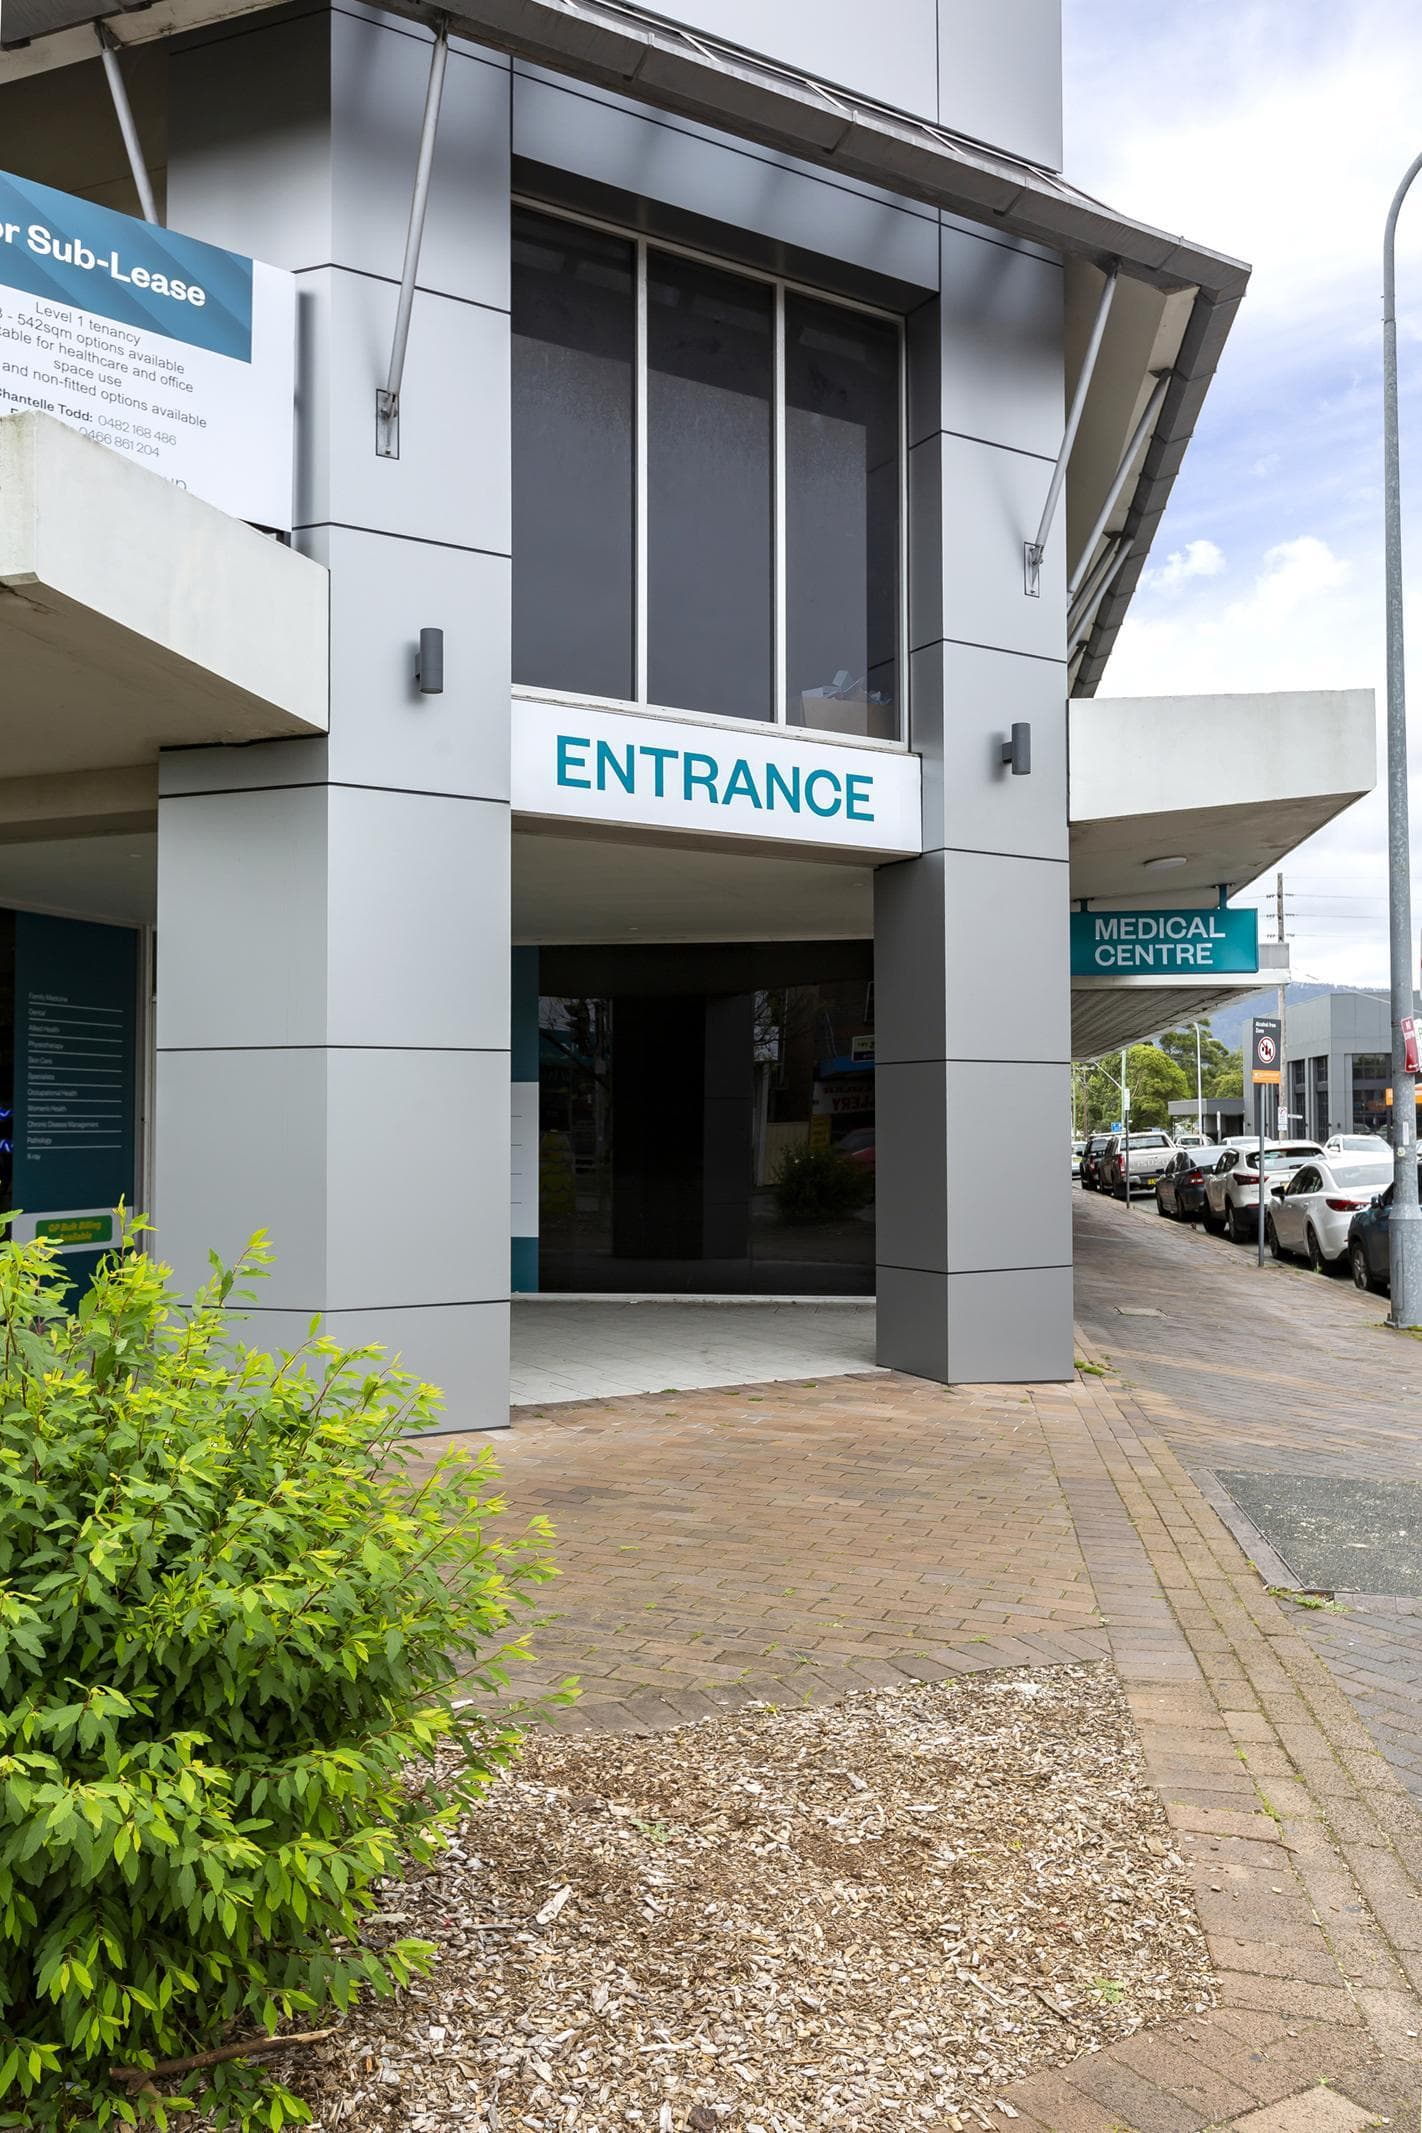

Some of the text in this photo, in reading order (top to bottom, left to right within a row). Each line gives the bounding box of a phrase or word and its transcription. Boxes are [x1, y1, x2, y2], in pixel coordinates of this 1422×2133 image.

[27, 224, 206, 307] Sub-Lease
[17, 313, 72, 340] 542sqm
[76, 334, 125, 356] options
[128, 349, 185, 374] available
[36, 301, 141, 347] Level 1 tenancy
[37, 335, 55, 351] for
[59, 342, 129, 373] healthcare
[132, 367, 156, 381] and
[160, 375, 194, 393] office
[53, 360, 122, 388] space use
[2, 362, 207, 428] and non-fitted options available
[57, 403, 93, 423] Todd:
[98, 414, 130, 433] 0482
[132, 424, 152, 439] 168
[154, 431, 177, 446] 486
[114, 436, 134, 450] 861
[136, 442, 160, 457] 204
[556, 734, 875, 822] ENTRANCE
[1095, 916, 1226, 940] MEDICAL
[1094, 943, 1214, 967] CENTRE
